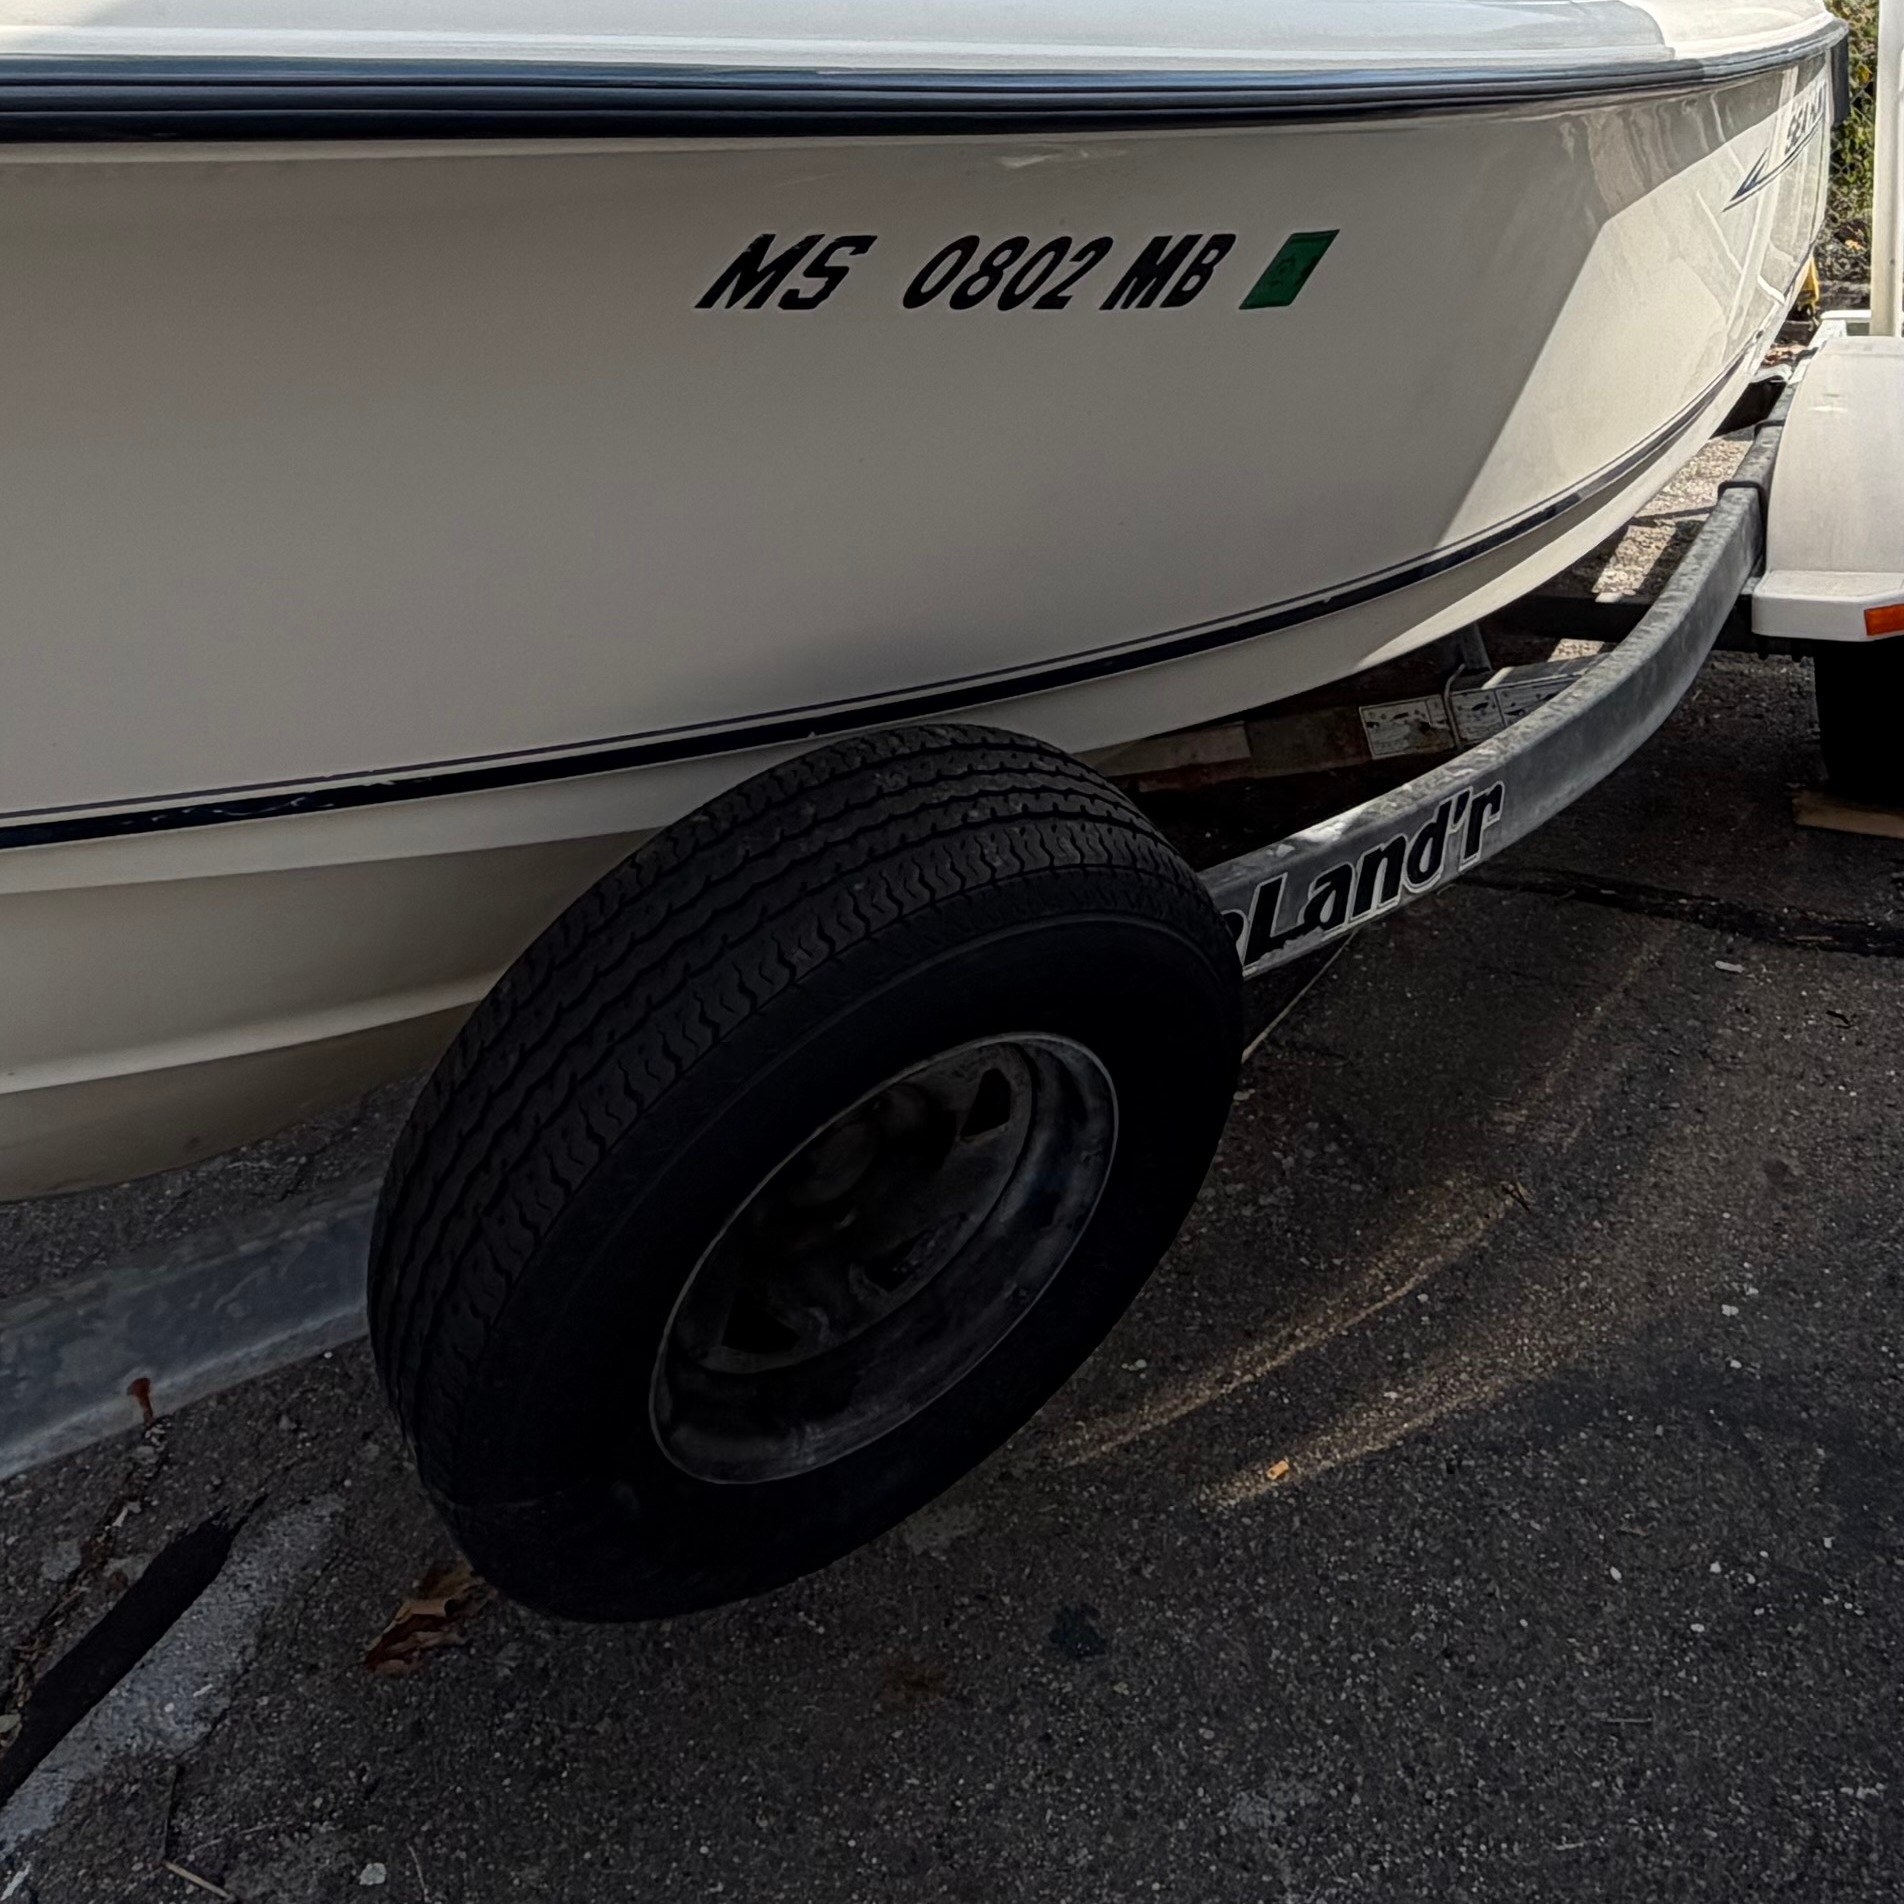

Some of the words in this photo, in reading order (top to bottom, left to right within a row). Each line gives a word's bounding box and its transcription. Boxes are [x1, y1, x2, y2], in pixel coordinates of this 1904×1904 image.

[694, 233, 878, 311] MS
[901, 234, 1114, 311] 0802
[1098, 233, 1237, 312] MB
